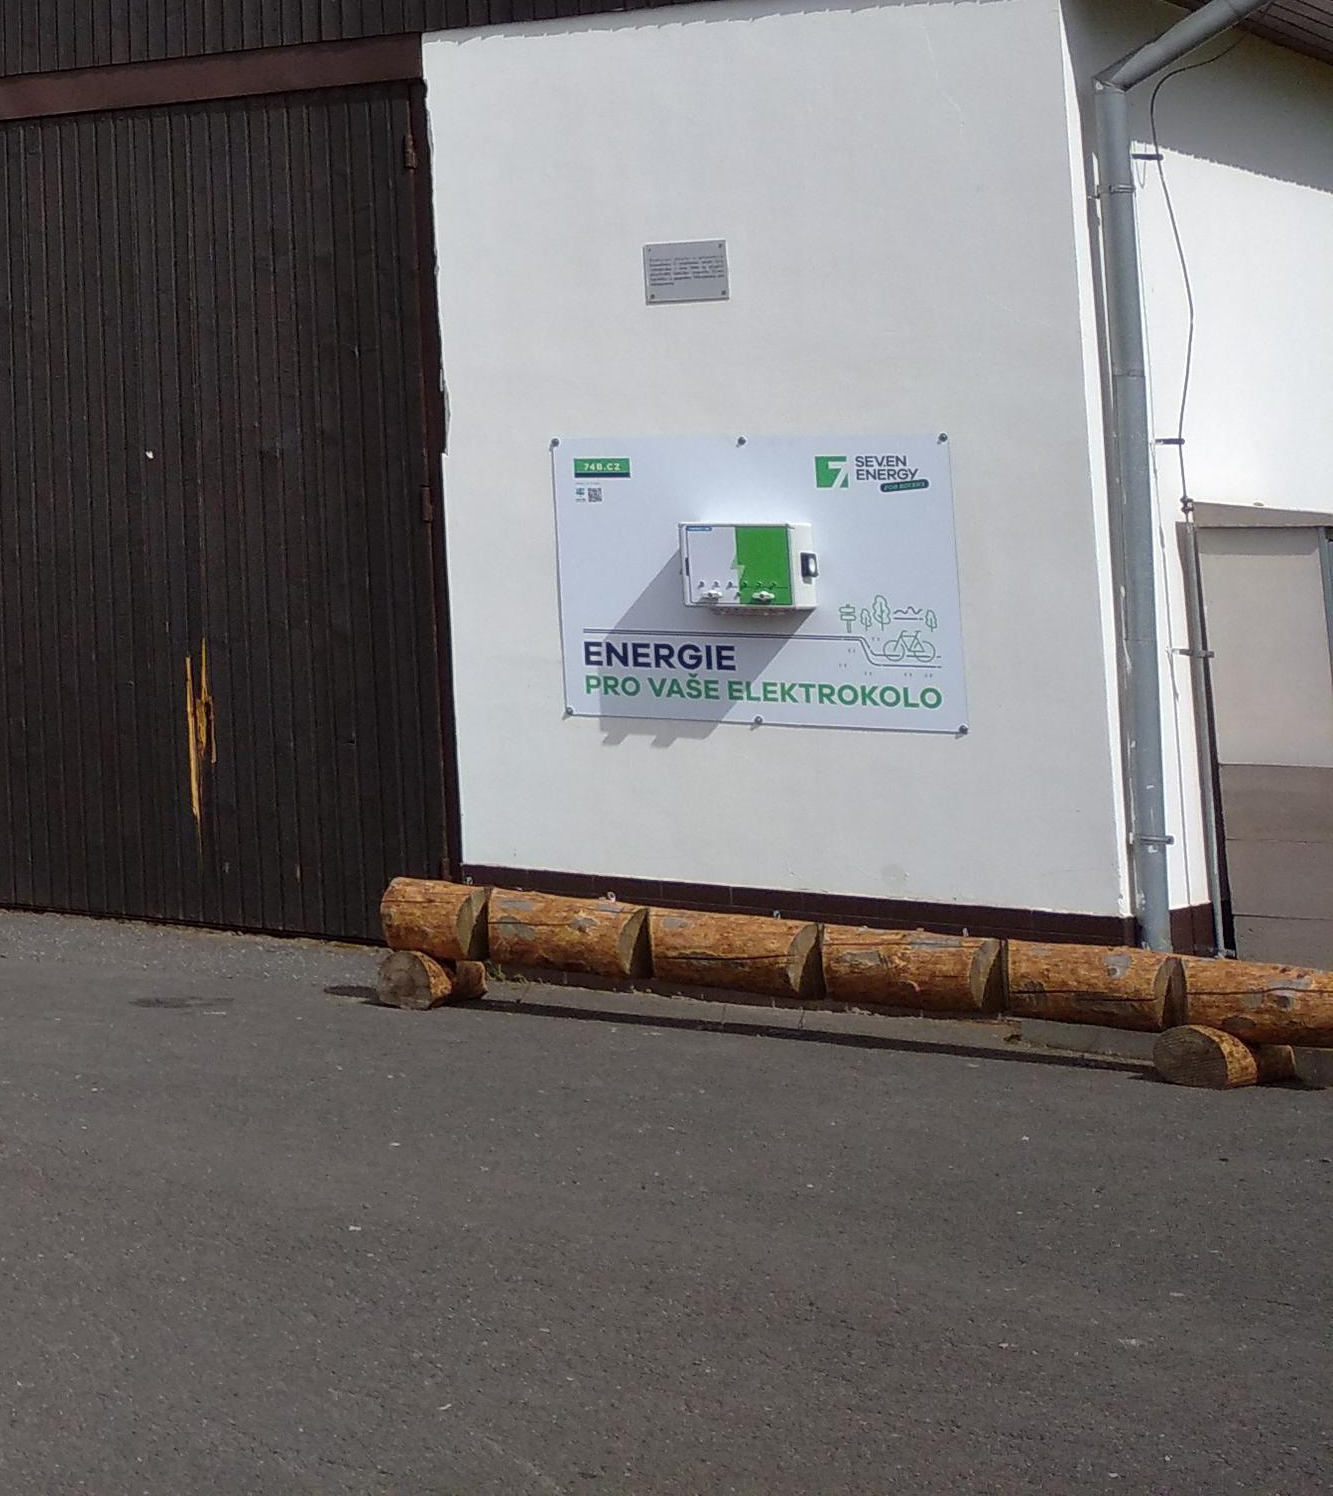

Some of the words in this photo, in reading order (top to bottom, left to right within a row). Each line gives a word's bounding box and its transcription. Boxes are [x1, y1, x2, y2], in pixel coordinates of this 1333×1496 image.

[856, 468, 918, 481] ENERGY
[584, 641, 736, 671] ENERGIE
[585, 675, 641, 697] PRO
[647, 673, 720, 700] VAŠE
[727, 680, 942, 709] ELEKTROKOLO
